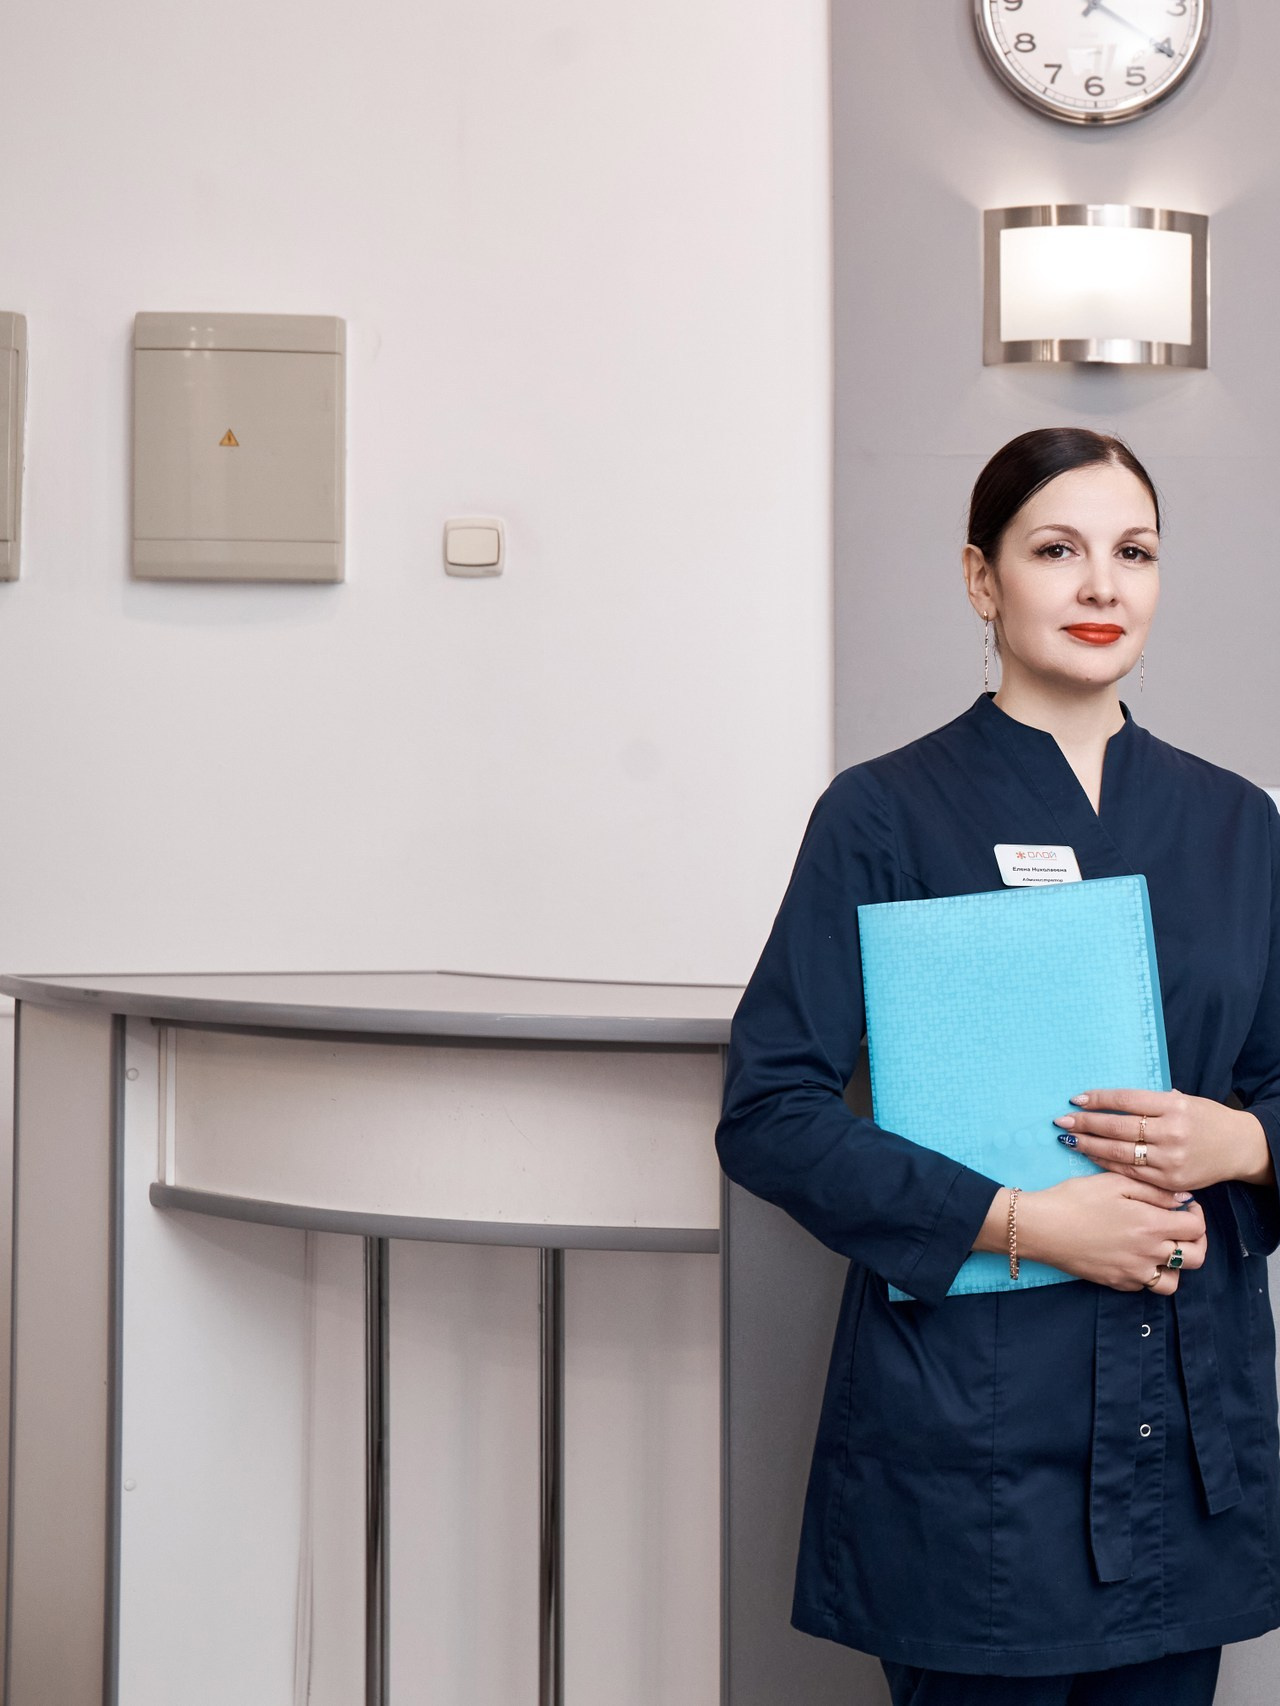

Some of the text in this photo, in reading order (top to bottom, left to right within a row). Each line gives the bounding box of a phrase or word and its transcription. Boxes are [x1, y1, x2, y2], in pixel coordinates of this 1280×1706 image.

[1166, 0, 1187, 17] 3
[1013, 33, 1036, 53] 8
[1044, 64, 1062, 84] 7
[1125, 66, 1147, 86] 5
[1084, 76, 1105, 96] 6
